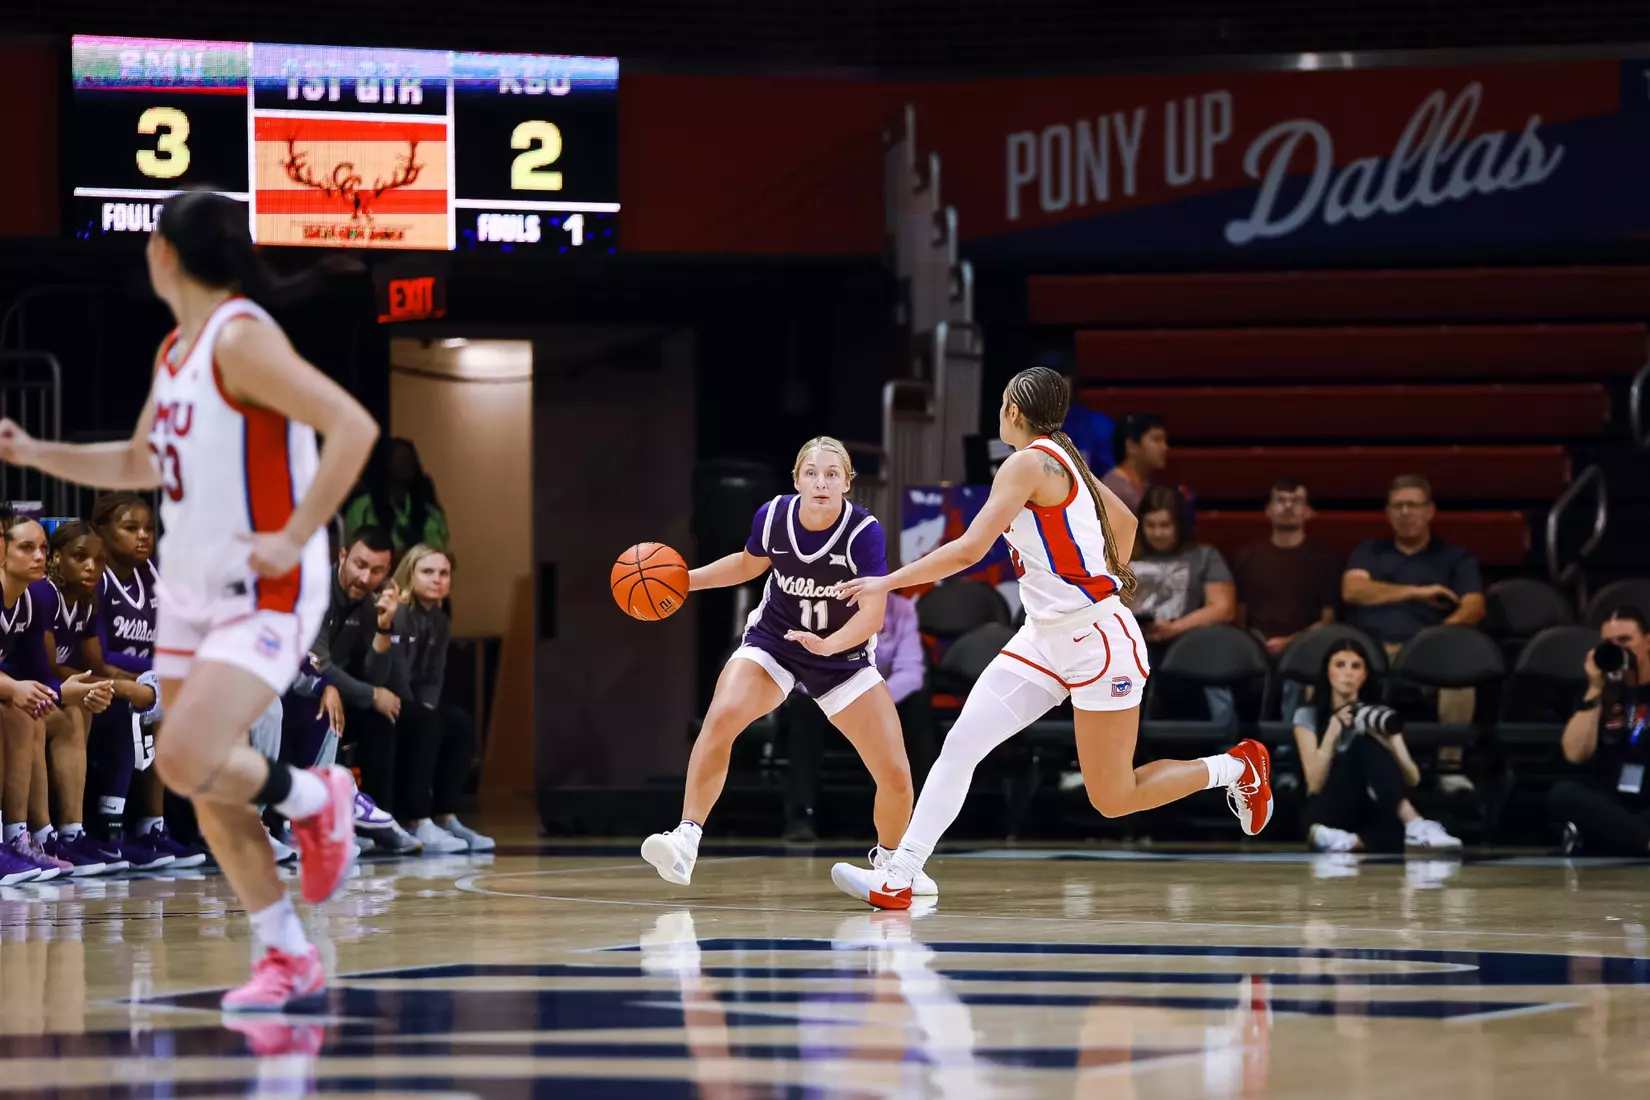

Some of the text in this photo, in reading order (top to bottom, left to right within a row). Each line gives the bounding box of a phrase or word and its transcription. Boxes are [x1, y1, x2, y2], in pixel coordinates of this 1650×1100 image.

[135, 106, 190, 179] 3
[510, 120, 563, 191] 2
[1006, 90, 1233, 221] PONY UP
[1224, 82, 1565, 245] Dallas
[477, 213, 585, 246] FOULS 1
[389, 276, 435, 317] EXIT
[799, 599, 829, 631] 11
